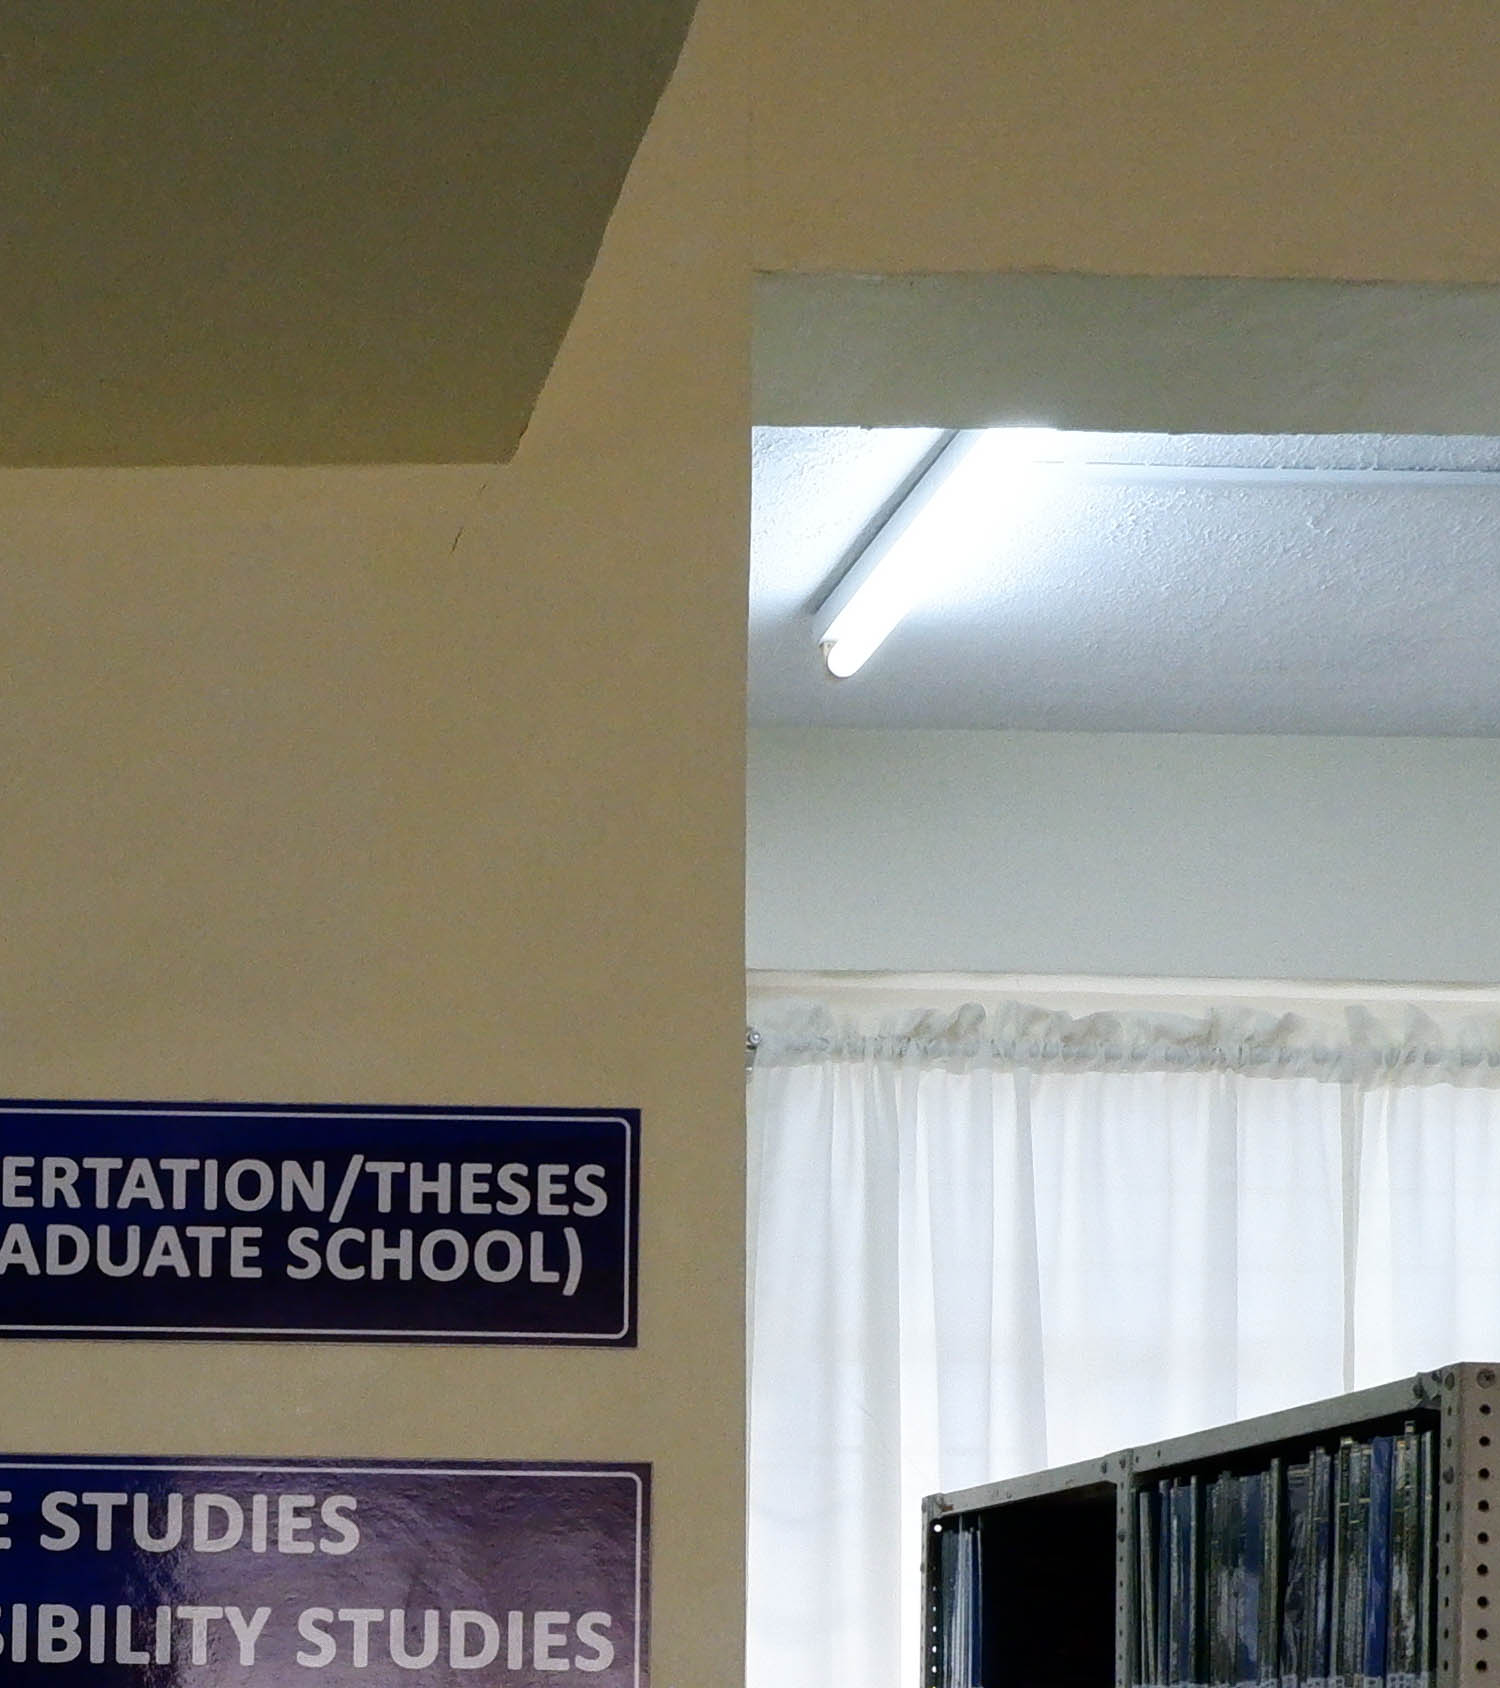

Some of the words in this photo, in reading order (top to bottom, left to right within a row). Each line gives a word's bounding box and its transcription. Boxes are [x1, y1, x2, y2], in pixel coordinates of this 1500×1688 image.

[285, 1227, 584, 1297] SCHOOL)
[39, 1490, 361, 1557] STUDIES
[296, 1609, 616, 1674] STUDIES
